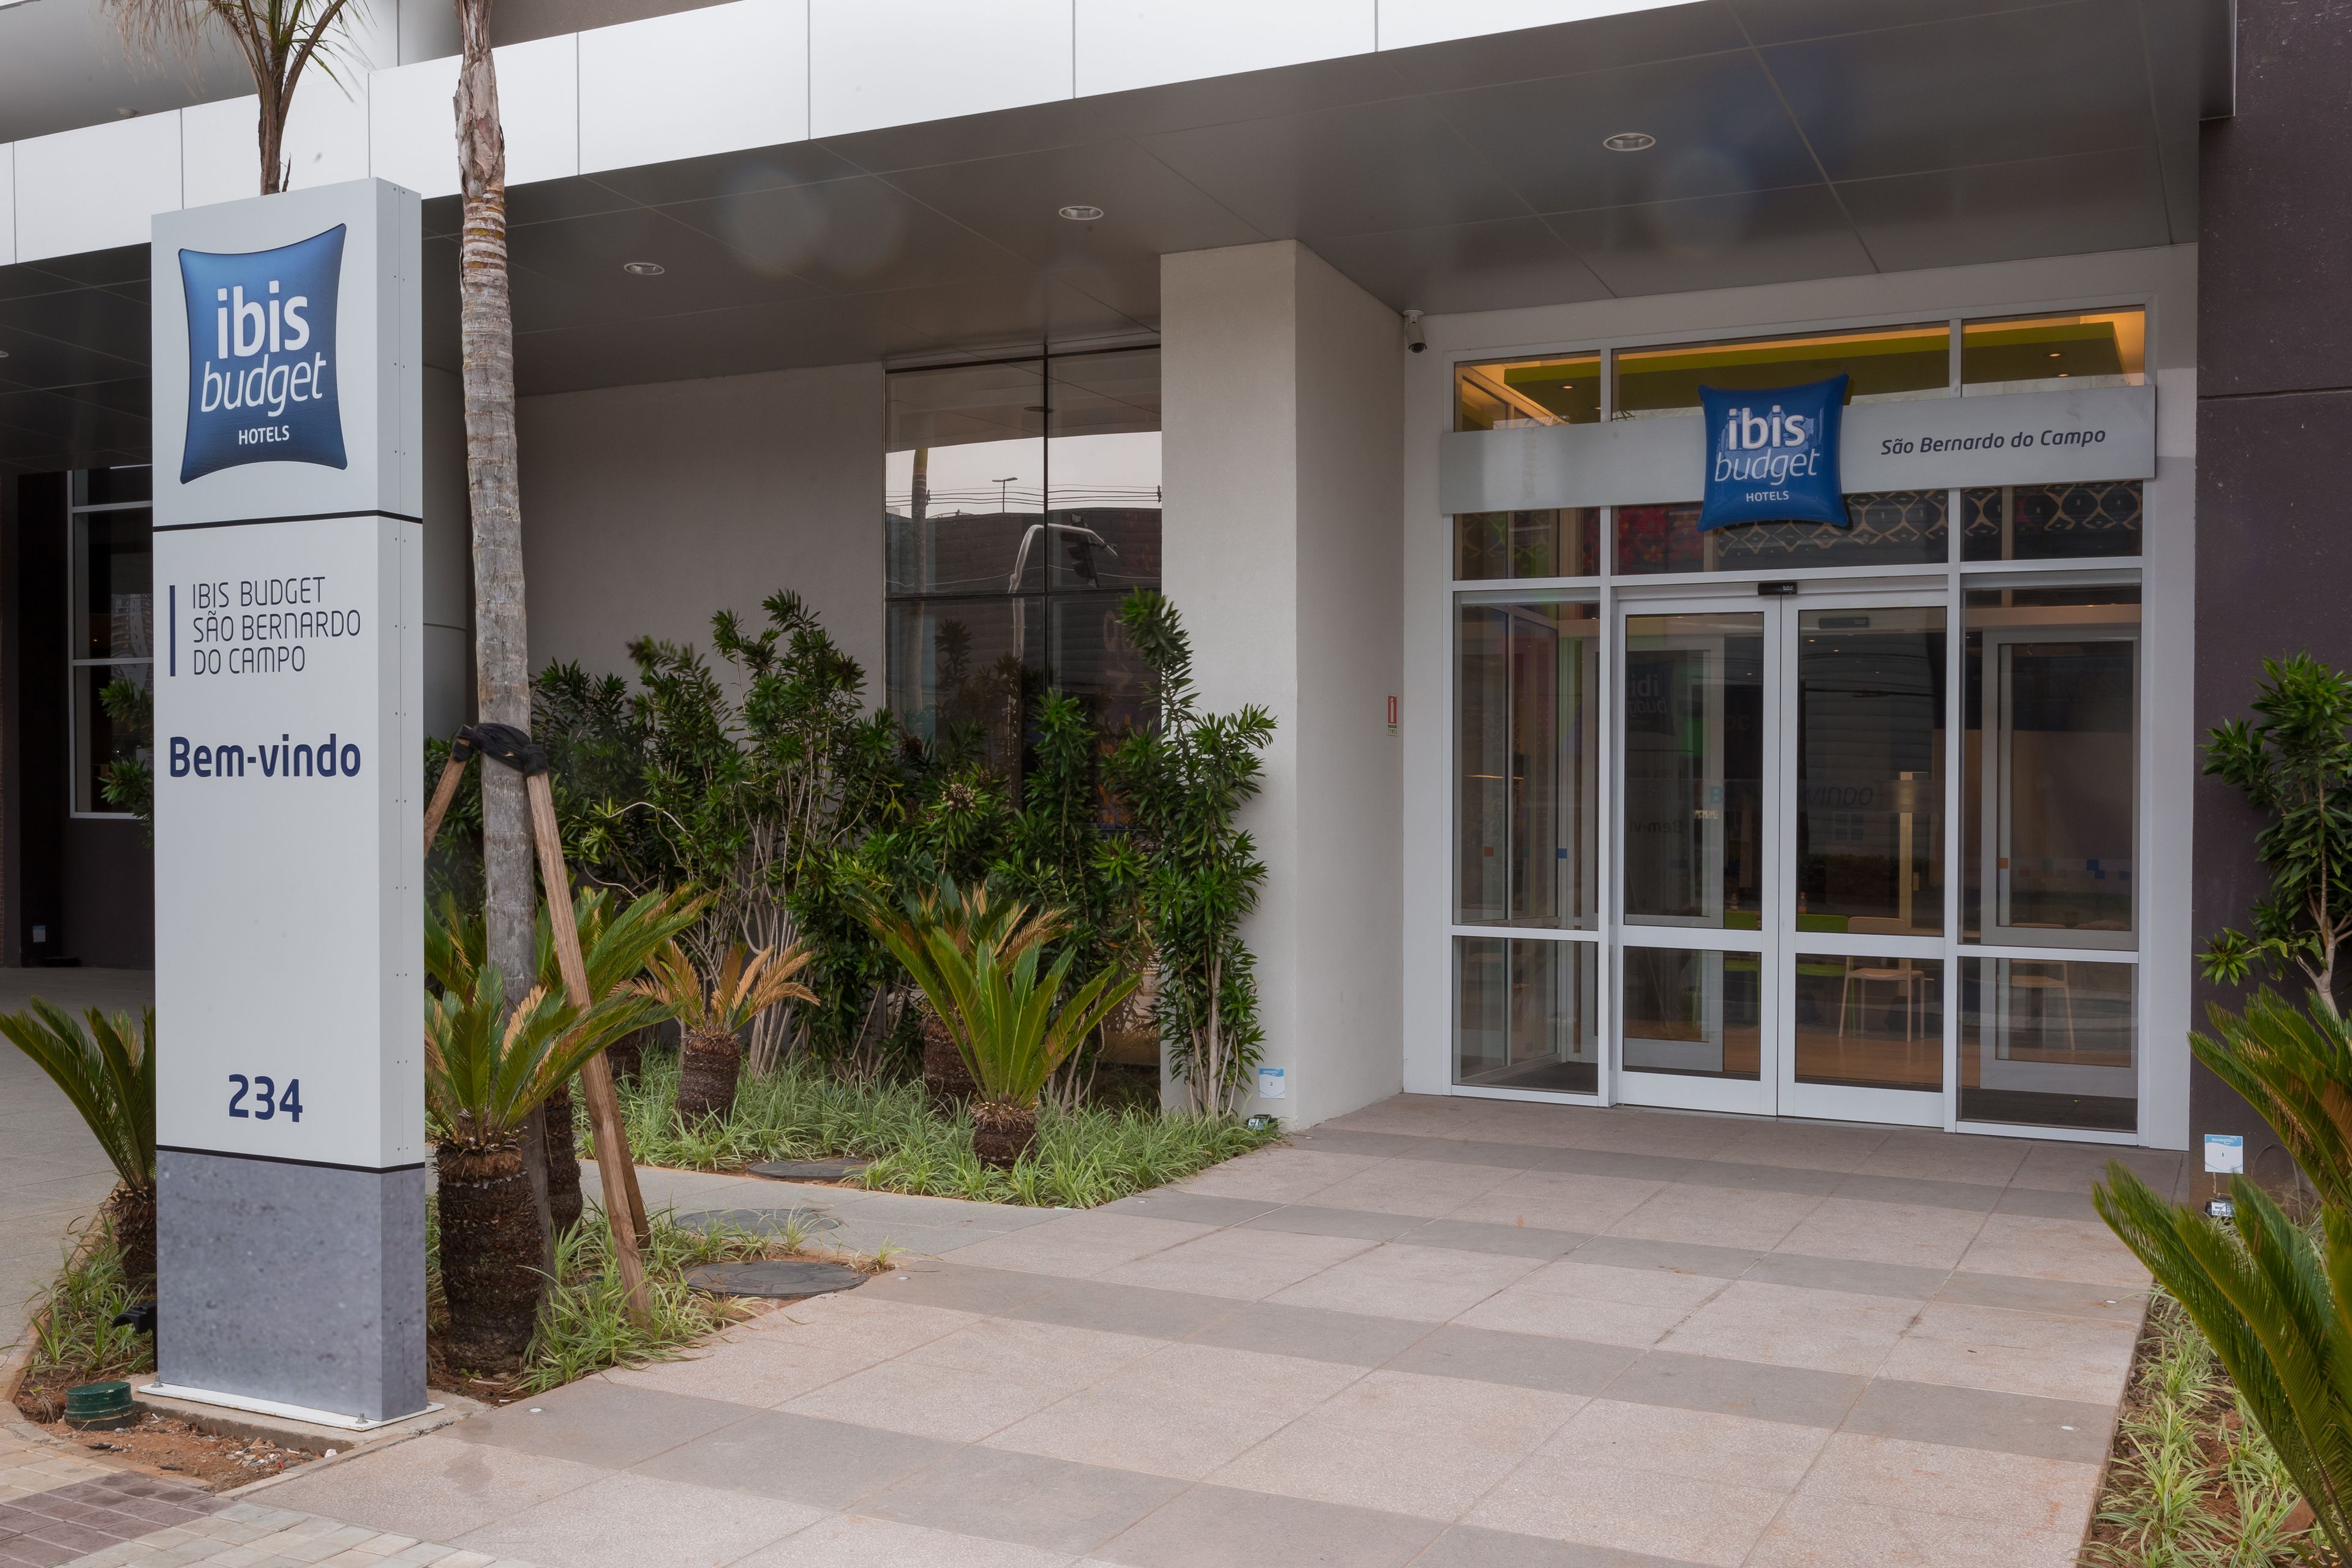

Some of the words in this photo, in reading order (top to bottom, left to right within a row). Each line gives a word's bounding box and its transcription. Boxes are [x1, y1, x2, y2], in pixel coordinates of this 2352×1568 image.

[217, 281, 311, 359] ibis
[201, 352, 327, 418] budget
[239, 425, 290, 445] HOTELS
[1728, 405, 1806, 451] ibis
[1881, 438, 1915, 455] São
[1920, 432, 2005, 453] Bernardo
[2011, 431, 2034, 448] do
[2041, 429, 2106, 447] Campo
[1714, 448, 1820, 486] budget
[1746, 491, 1790, 502] HOTELS
[193, 582, 230, 609] IBIS
[241, 576, 326, 607] BUDGET
[193, 610, 235, 643] SÃO
[242, 609, 361, 641] BERNARDO
[193, 649, 222, 676] DO
[228, 646, 306, 674] CAMPO
[170, 733, 362, 778] Bem-vindo
[228, 1074, 304, 1123] 234
